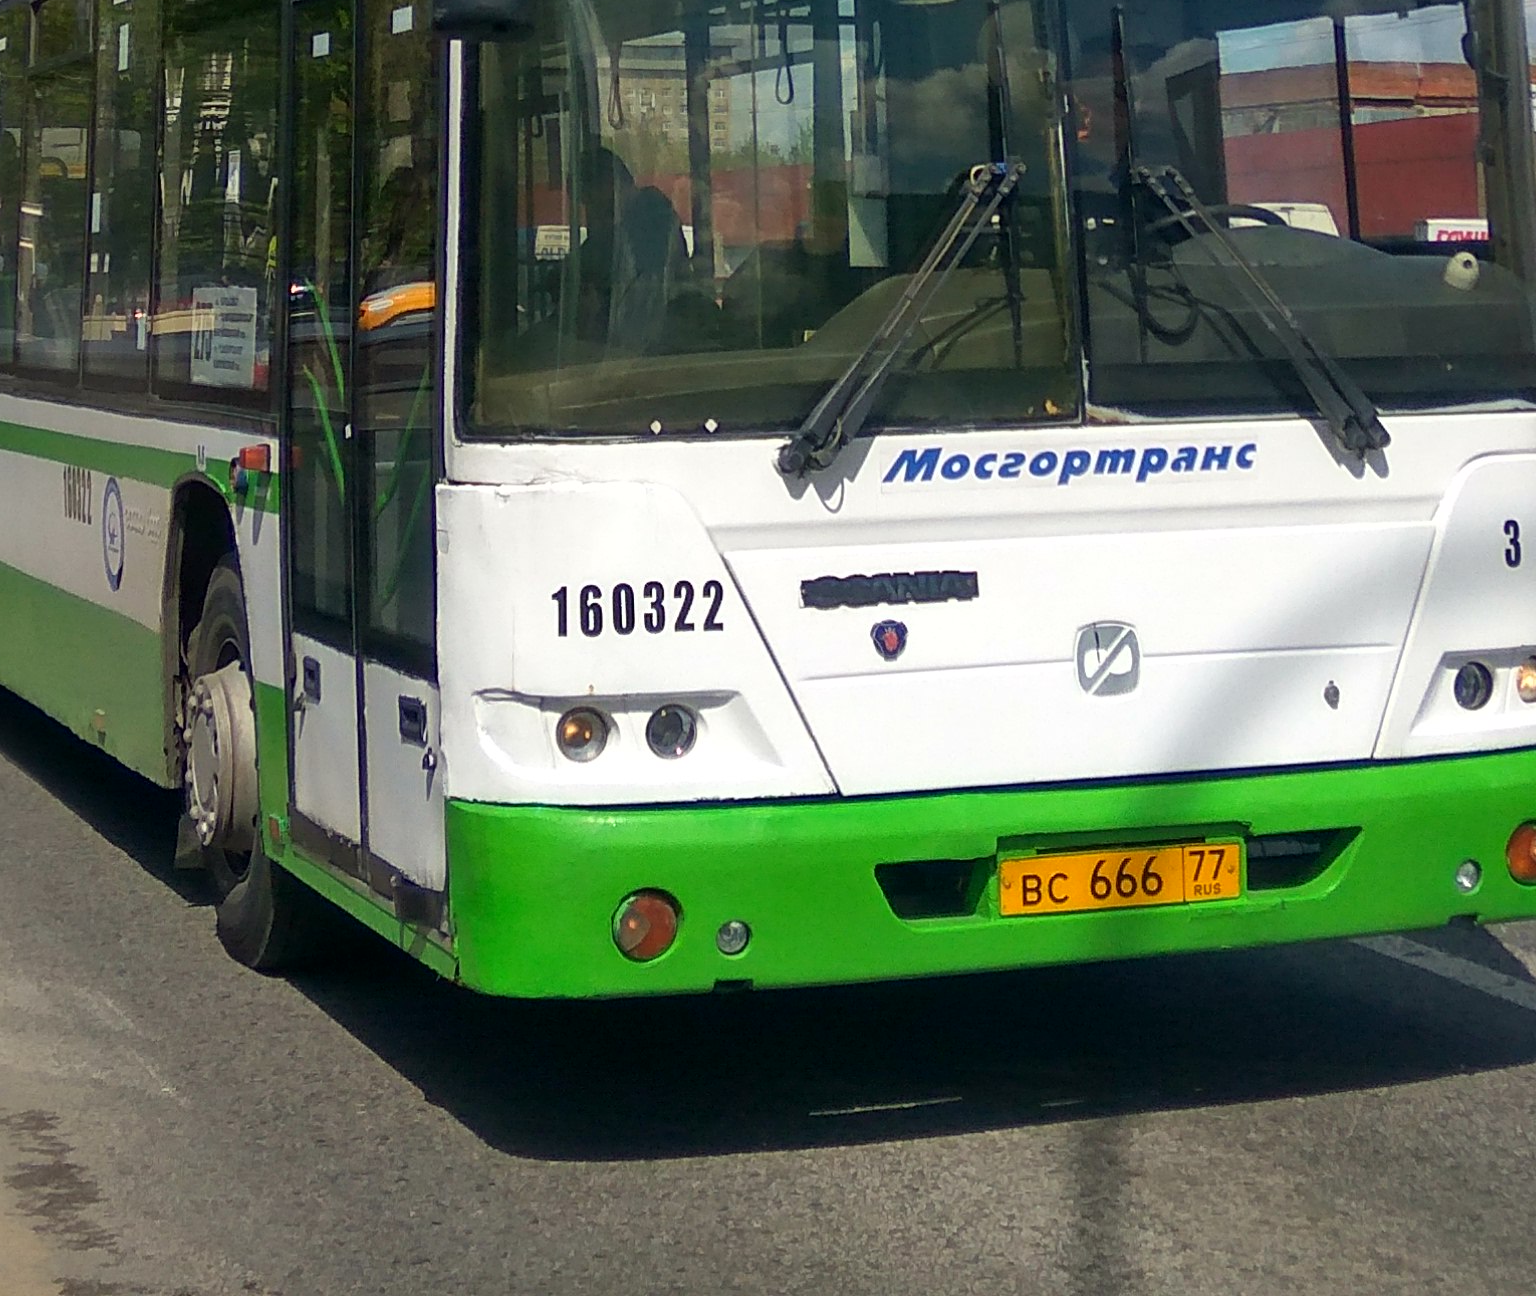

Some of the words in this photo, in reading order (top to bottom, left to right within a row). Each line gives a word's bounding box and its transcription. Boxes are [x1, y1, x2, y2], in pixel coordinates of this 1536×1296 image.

[882, 441, 1258, 485] Мосгортранс
[63, 465, 92, 525] 160322
[1502, 518, 1523, 568] 3
[551, 579, 726, 638] 160322
[1089, 853, 1165, 900] 666
[1188, 848, 1226, 881] 77
[1193, 882, 1222, 897] RUS
